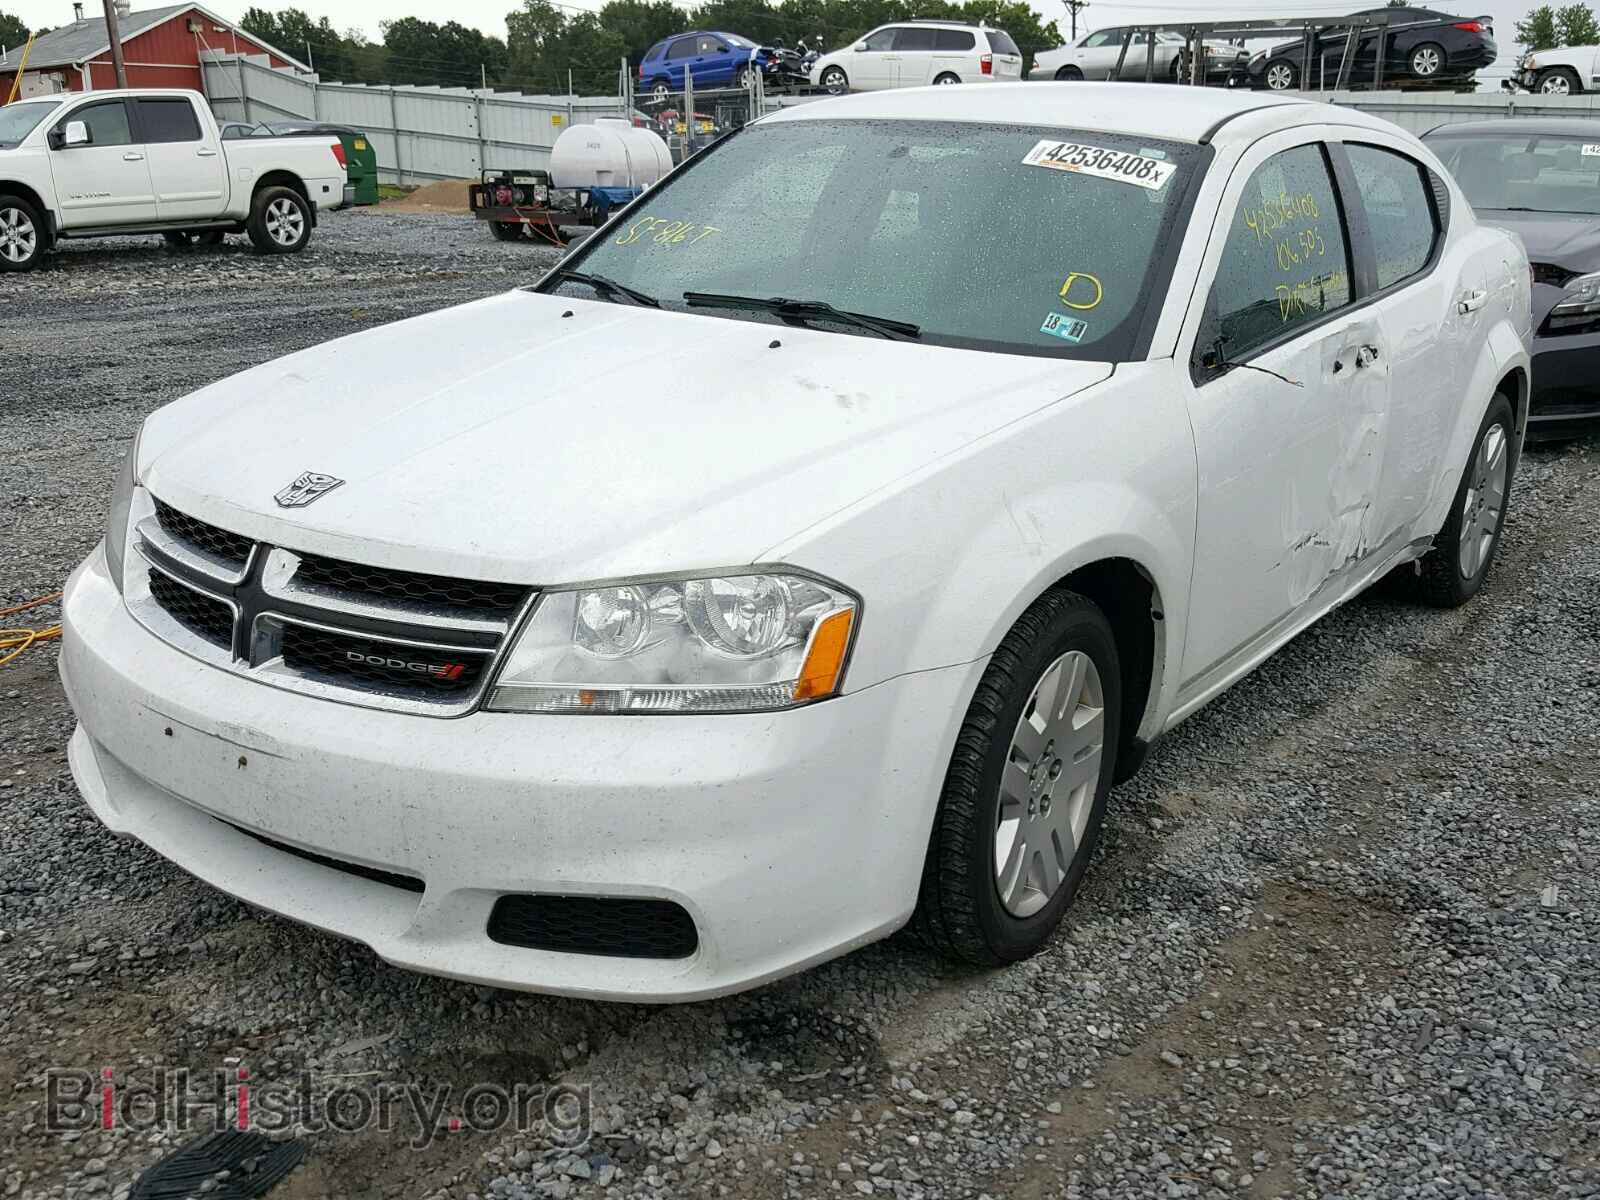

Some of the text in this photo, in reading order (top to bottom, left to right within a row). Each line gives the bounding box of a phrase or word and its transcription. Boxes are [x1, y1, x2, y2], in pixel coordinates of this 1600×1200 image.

[1059, 271, 1102, 310] D
[1044, 314, 1060, 330] 18
[346, 650, 448, 676] DODGE
